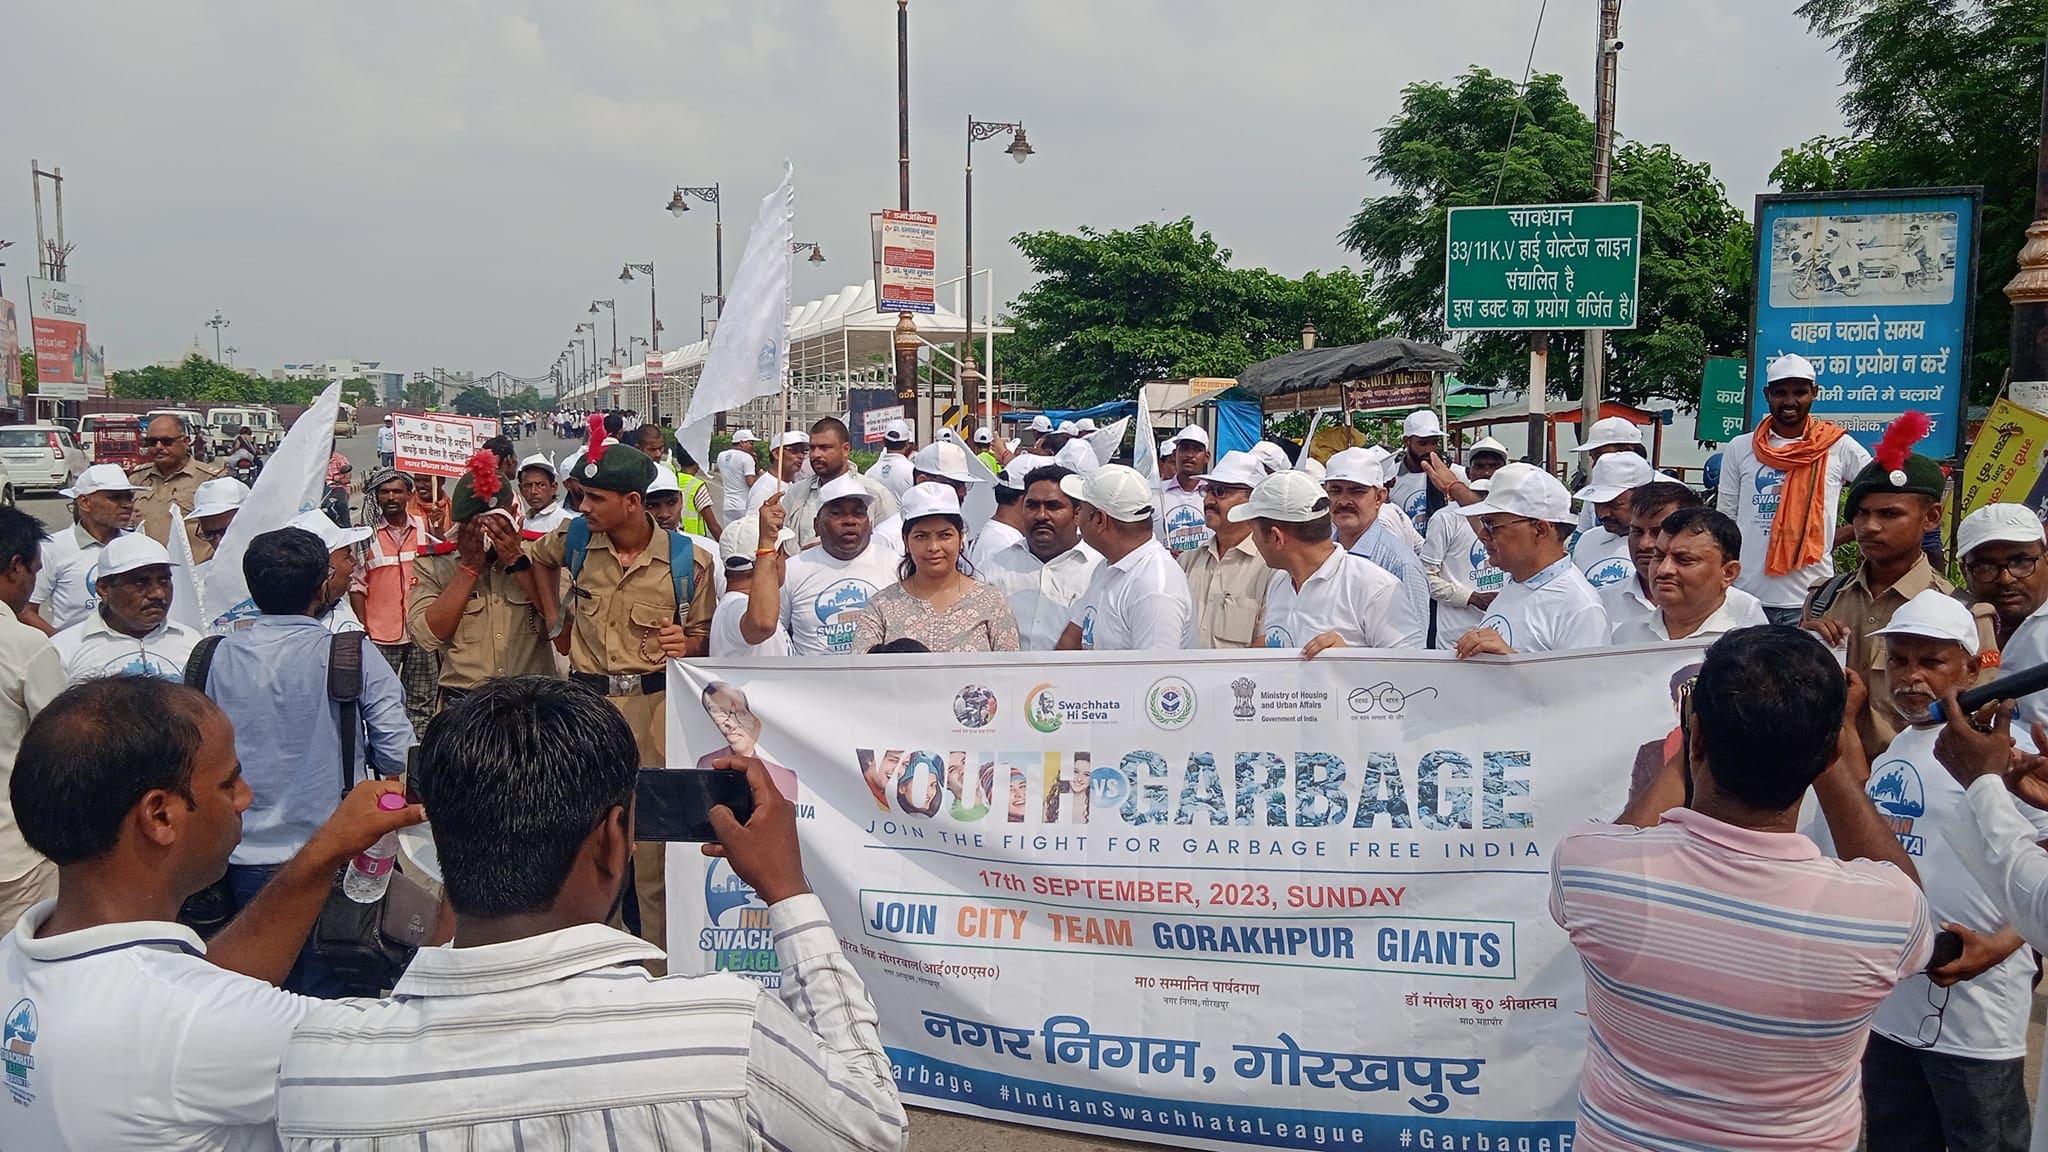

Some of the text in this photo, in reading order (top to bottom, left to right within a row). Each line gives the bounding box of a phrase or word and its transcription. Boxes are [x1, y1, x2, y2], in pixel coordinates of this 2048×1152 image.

[1508, 208, 1574, 228] सावधान
[1518, 231, 1541, 262] हाई
[1545, 231, 1590, 259] वोल्टेज
[1594, 237, 1632, 260] लाइन
[1505, 263, 1575, 292] संचालित है
[1453, 299, 1474, 321] इस
[1477, 299, 1508, 318] डक्ट
[1512, 299, 1530, 318] का
[1534, 293, 1570, 318] प्रयोग
[1576, 291, 1614, 319] वर्जित
[1790, 313, 1926, 343] वाहन चलाते समय
[1828, 355, 1852, 375] का
[1855, 347, 1899, 378] प्रयोग
[1903, 355, 1918, 375] न
[1920, 347, 1951, 375] करें
[1847, 385, 1878, 401] गति
[1058, 700, 1120, 710] Swachhata
[1260, 690, 1328, 701] Ministry of Housing
[1261, 701, 1322, 709] and Urban Affairs
[1067, 710, 1108, 720] Hi Seva
[1304, 714, 1318, 722] India
[856, 749, 1535, 830] YOUTH VS GARBAGE
[865, 820, 1540, 858] JOIN THE FIGHT FOR GARBAGE FREE INDIA
[979, 870, 1406, 910] 17th SEPTEMBER, 2023, SUNDAY
[700, 928, 774, 951] SWACH
[870, 902, 1502, 968] JOIN CITY TEAM GORAKHPUR GIANTS
[716, 950, 782, 972] LEAGU
[860, 943, 876, 960] सिंह
[1159, 976, 1209, 991] सम्मानित
[1213, 978, 1260, 995] पार्षदगण
[1163, 997, 1177, 1005] नगर
[1405, 992, 1418, 1007] डॉ
[1423, 992, 1467, 1009] मंगलेश
[1499, 996, 1558, 1011] श्रीवास्तव
[921, 1010, 1486, 1114] नगर निगम, गोरखपुर
[893, 1064, 973, 1094] arbage
[1000, 1084, 1364, 1144] #IndianSwachhataLeague
